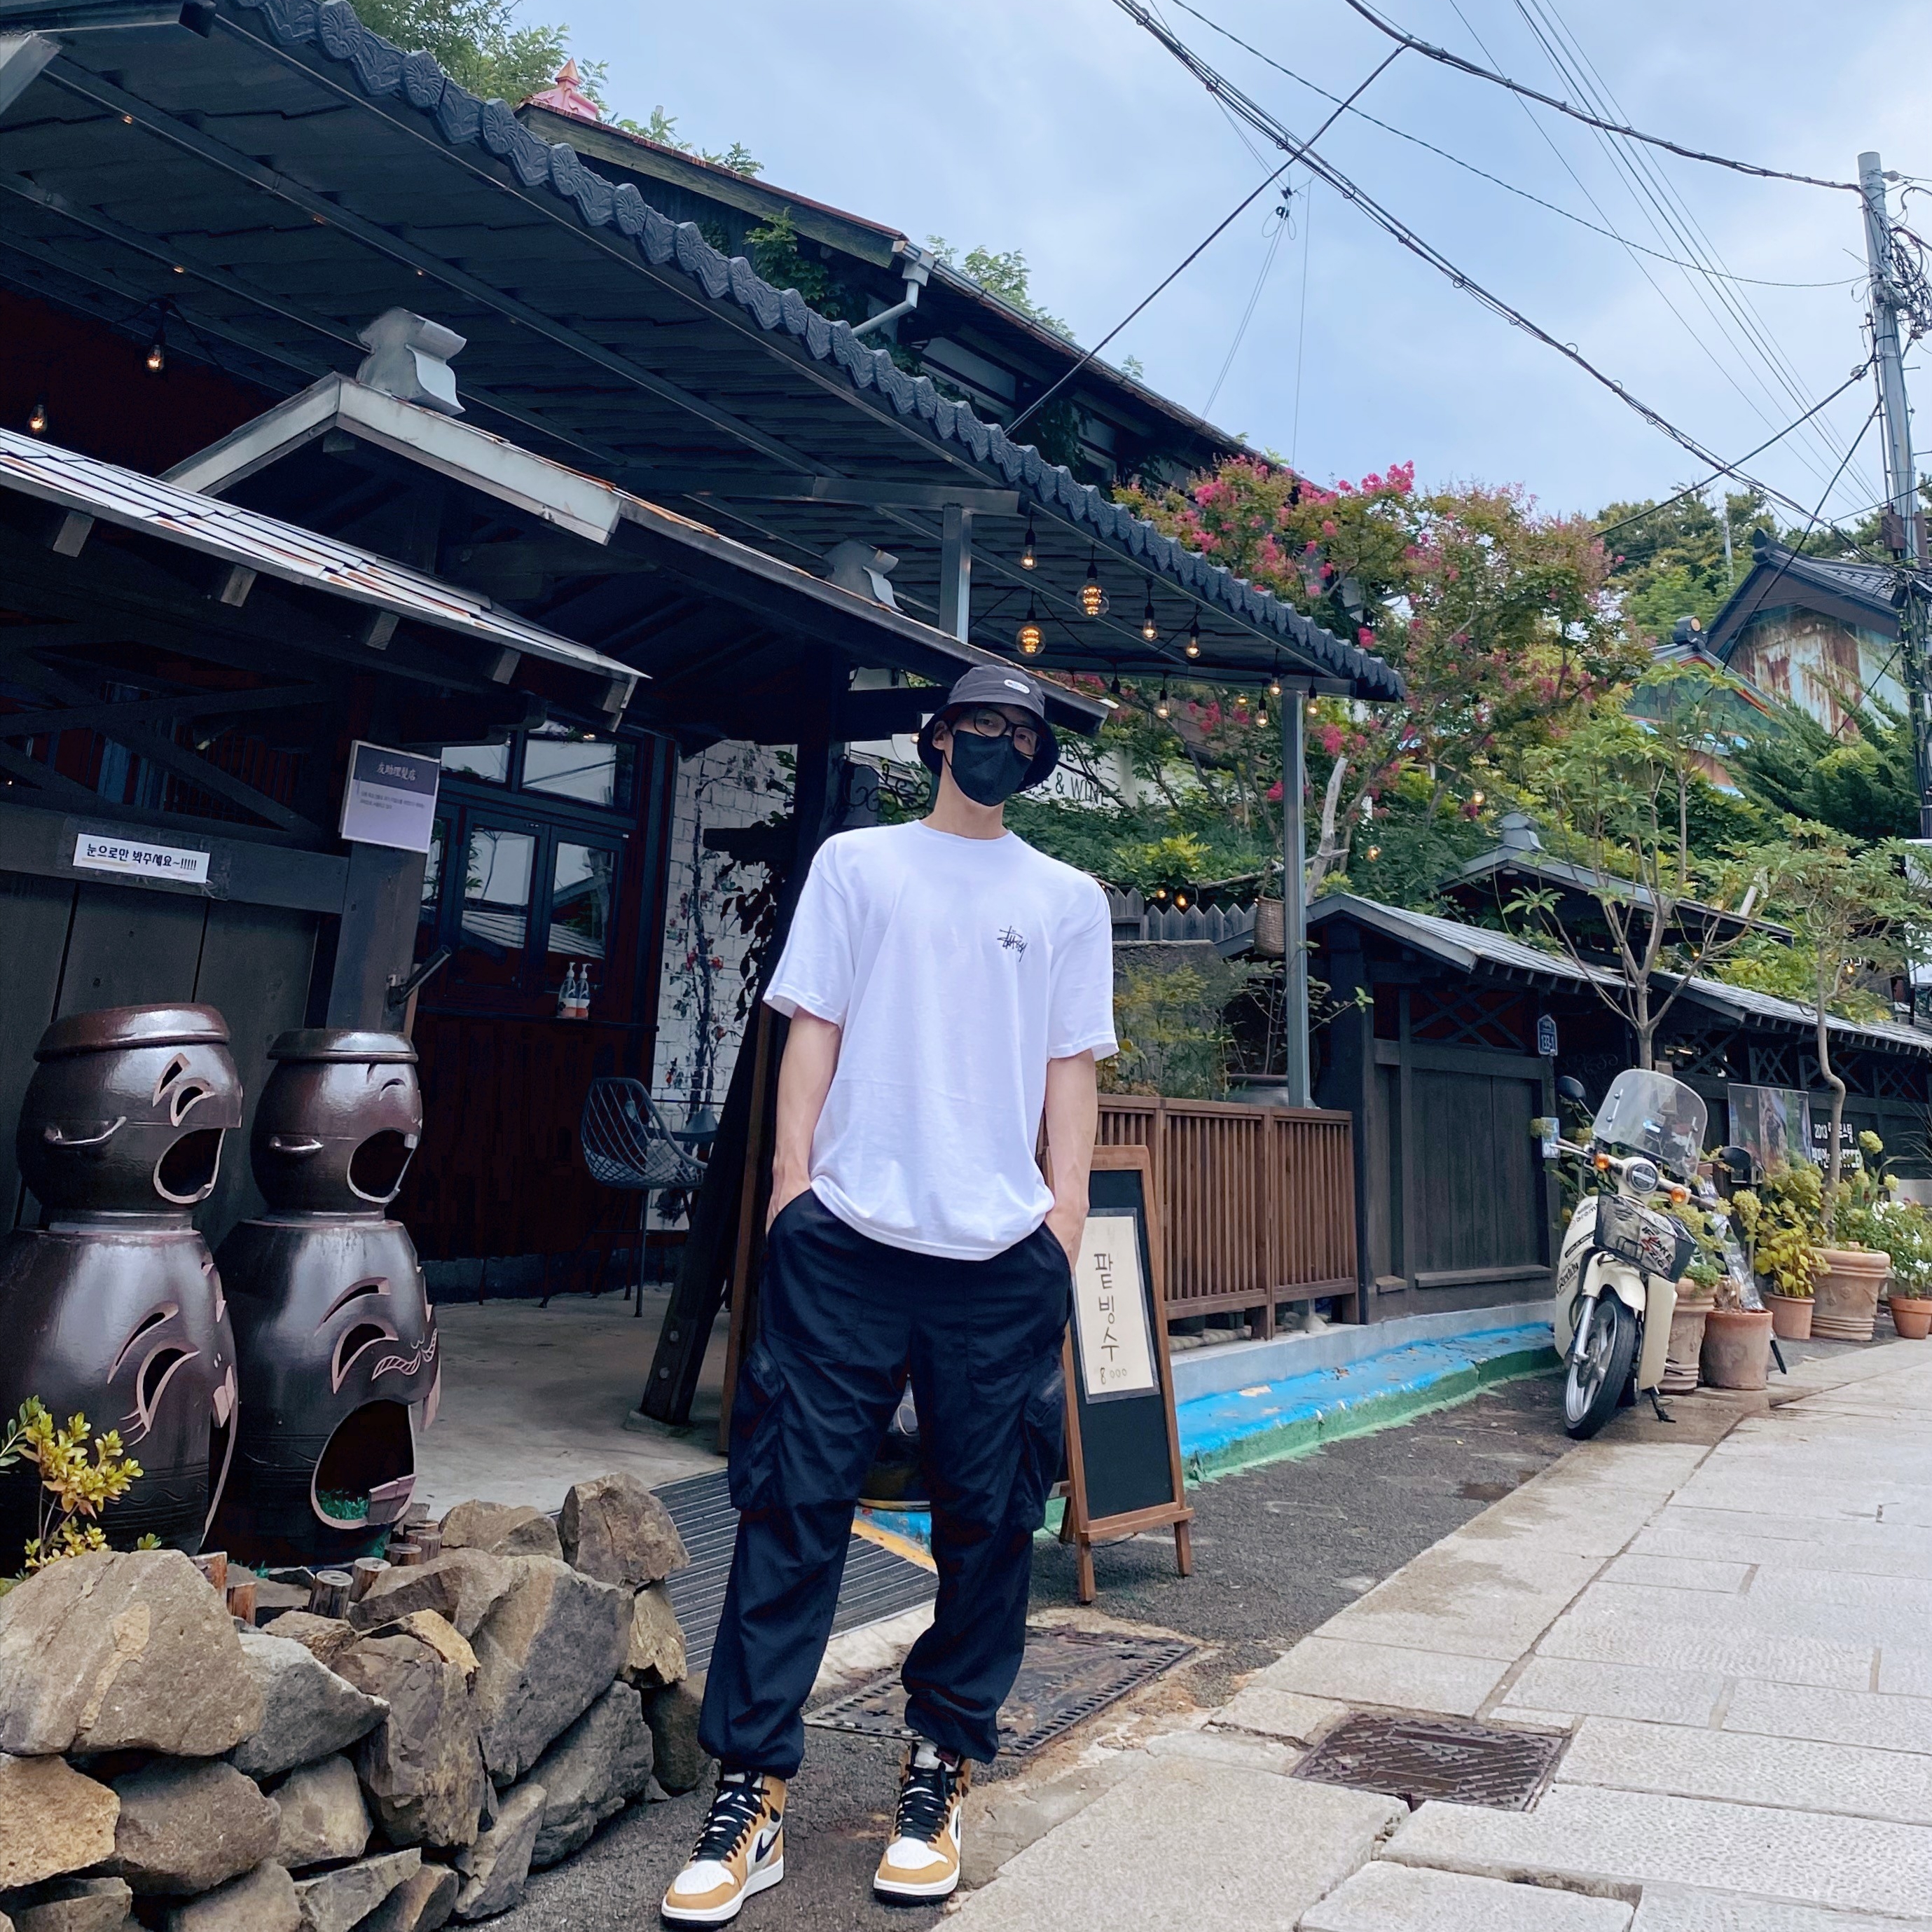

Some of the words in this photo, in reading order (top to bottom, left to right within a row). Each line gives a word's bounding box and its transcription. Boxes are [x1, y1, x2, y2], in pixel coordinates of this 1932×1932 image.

[1056, 771, 1065, 795] &
[87, 843, 129, 862] 눈으로만
[1093, 1253, 1119, 1362] 팥빙수
[1100, 1367, 1127, 1385] 8000
